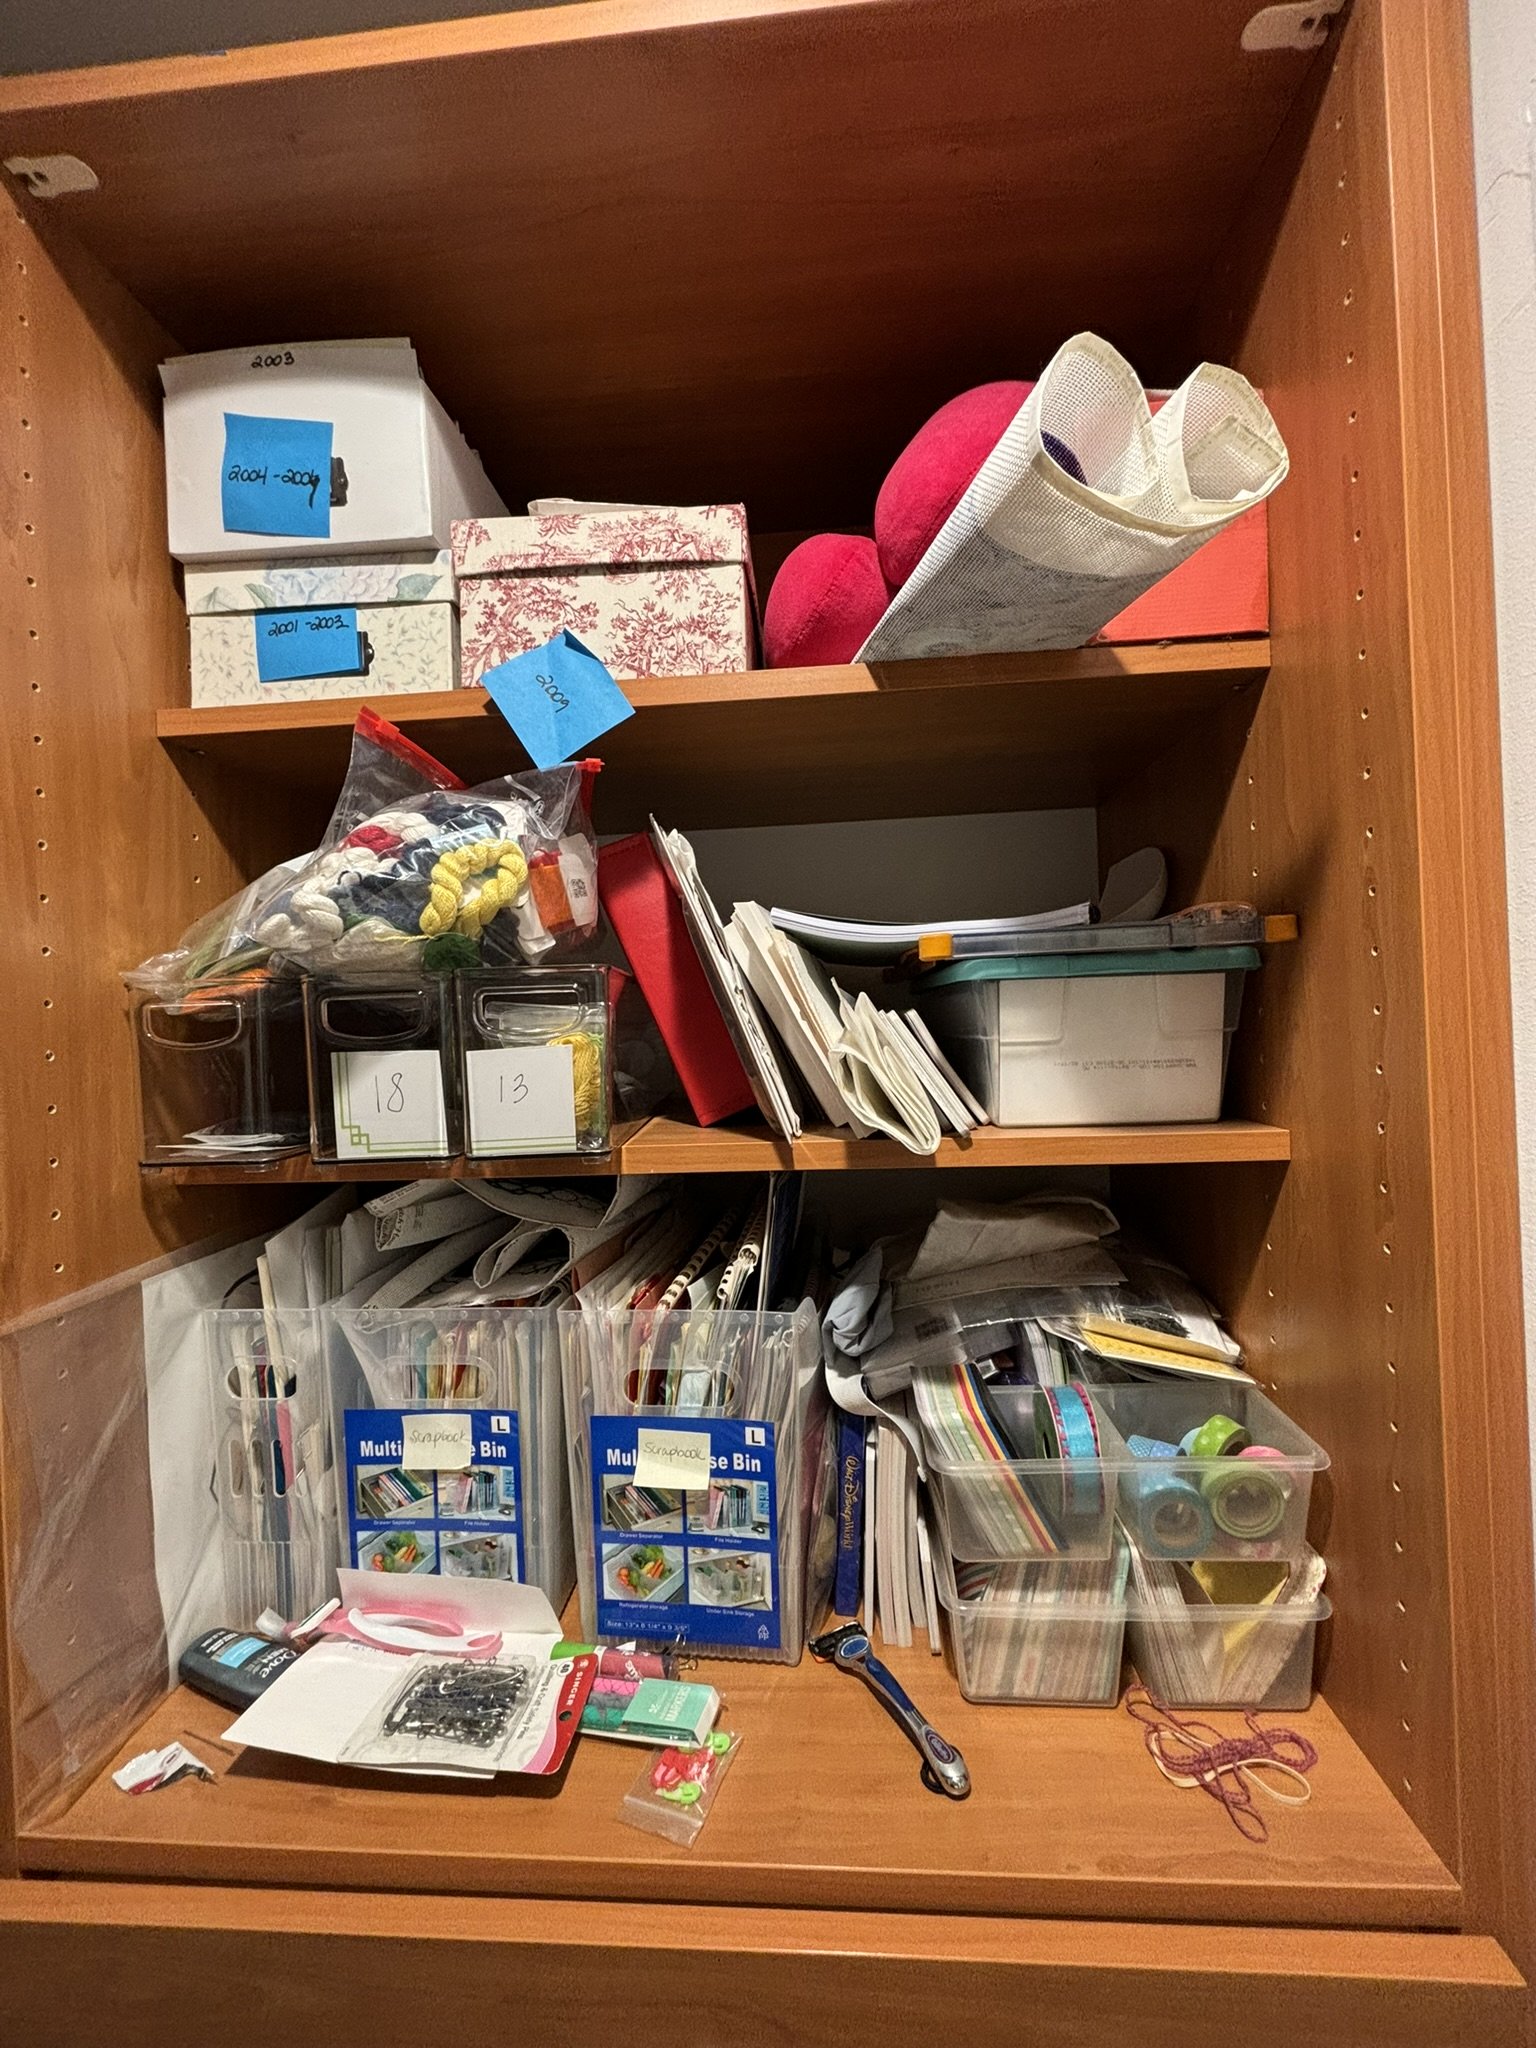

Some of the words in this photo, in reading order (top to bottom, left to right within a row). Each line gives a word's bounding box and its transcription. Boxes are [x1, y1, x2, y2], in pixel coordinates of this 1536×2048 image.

[251, 351, 295, 368] 2003
[228, 465, 267, 485] 2004
[268, 620, 298, 636] 2001
[536, 675, 570, 713] 2009
[375, 1072, 404, 1113] 18
[500, 1073, 528, 1104] 13
[496, 1418, 506, 1431] L
[751, 1430, 761, 1444] L
[360, 1440, 402, 1457] Multi
[480, 1442, 507, 1458] Bin
[642, 1441, 707, 1462] Scrapbook
[606, 1448, 637, 1466] Mul
[733, 1452, 761, 1472] Bin
[734, 1610, 755, 1618] Storage
[260, 1648, 298, 1678] Dove
[566, 1671, 584, 1706] SINGER
